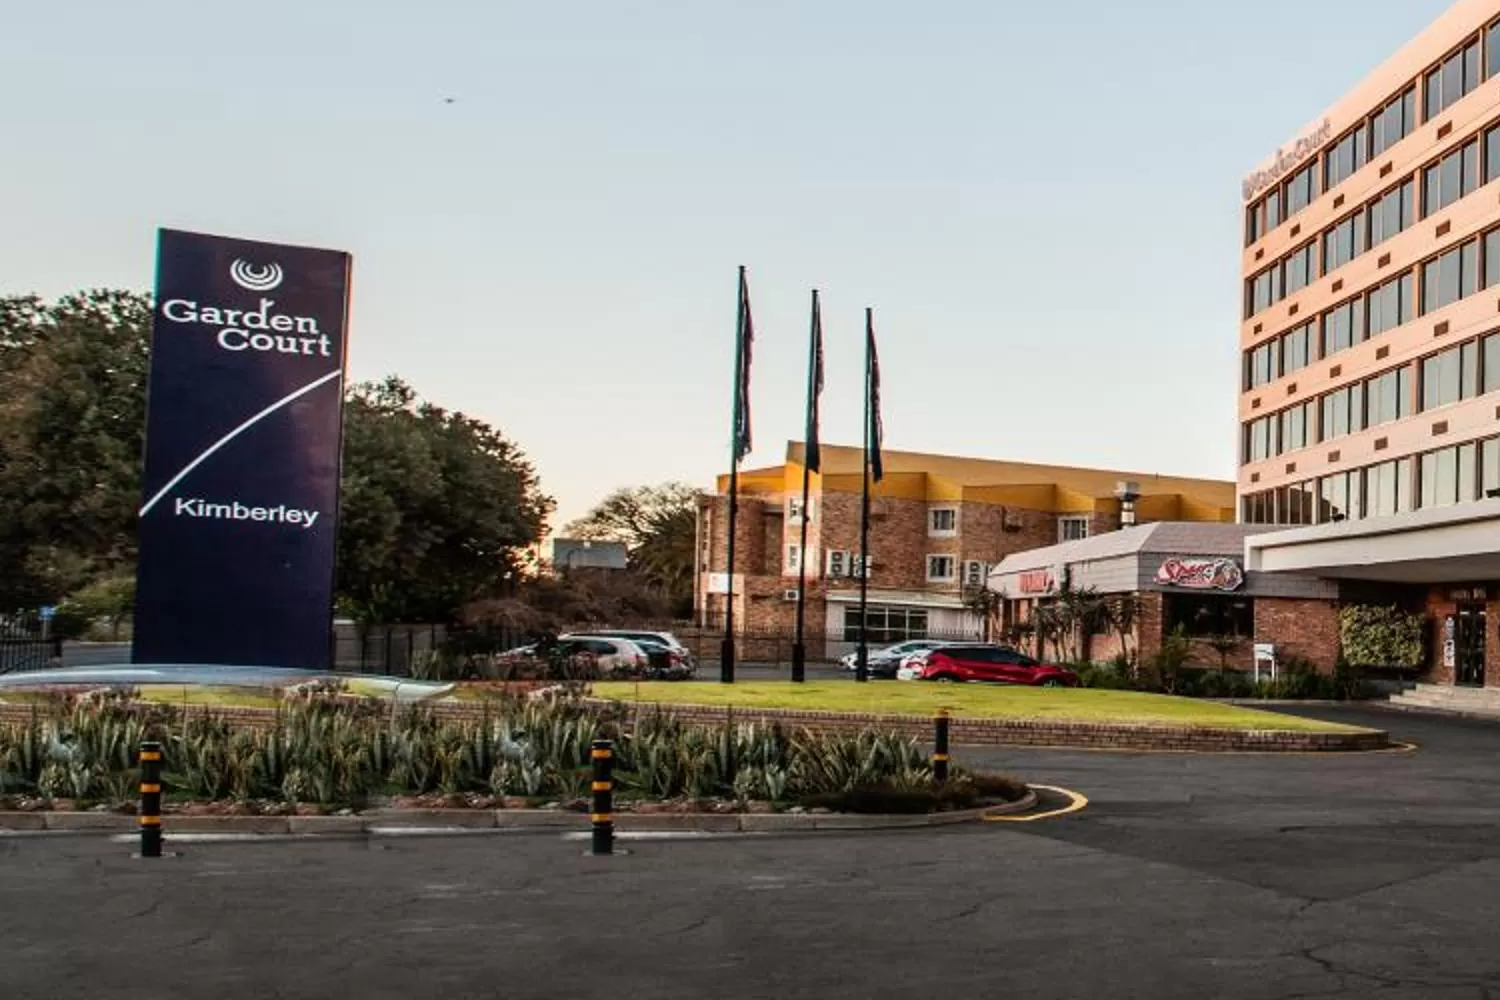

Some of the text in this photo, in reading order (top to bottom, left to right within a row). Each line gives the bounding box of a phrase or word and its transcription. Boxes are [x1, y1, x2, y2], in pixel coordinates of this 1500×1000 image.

[162, 298, 319, 335] Garden
[217, 327, 331, 356] Court
[175, 498, 319, 528] Kimberley
